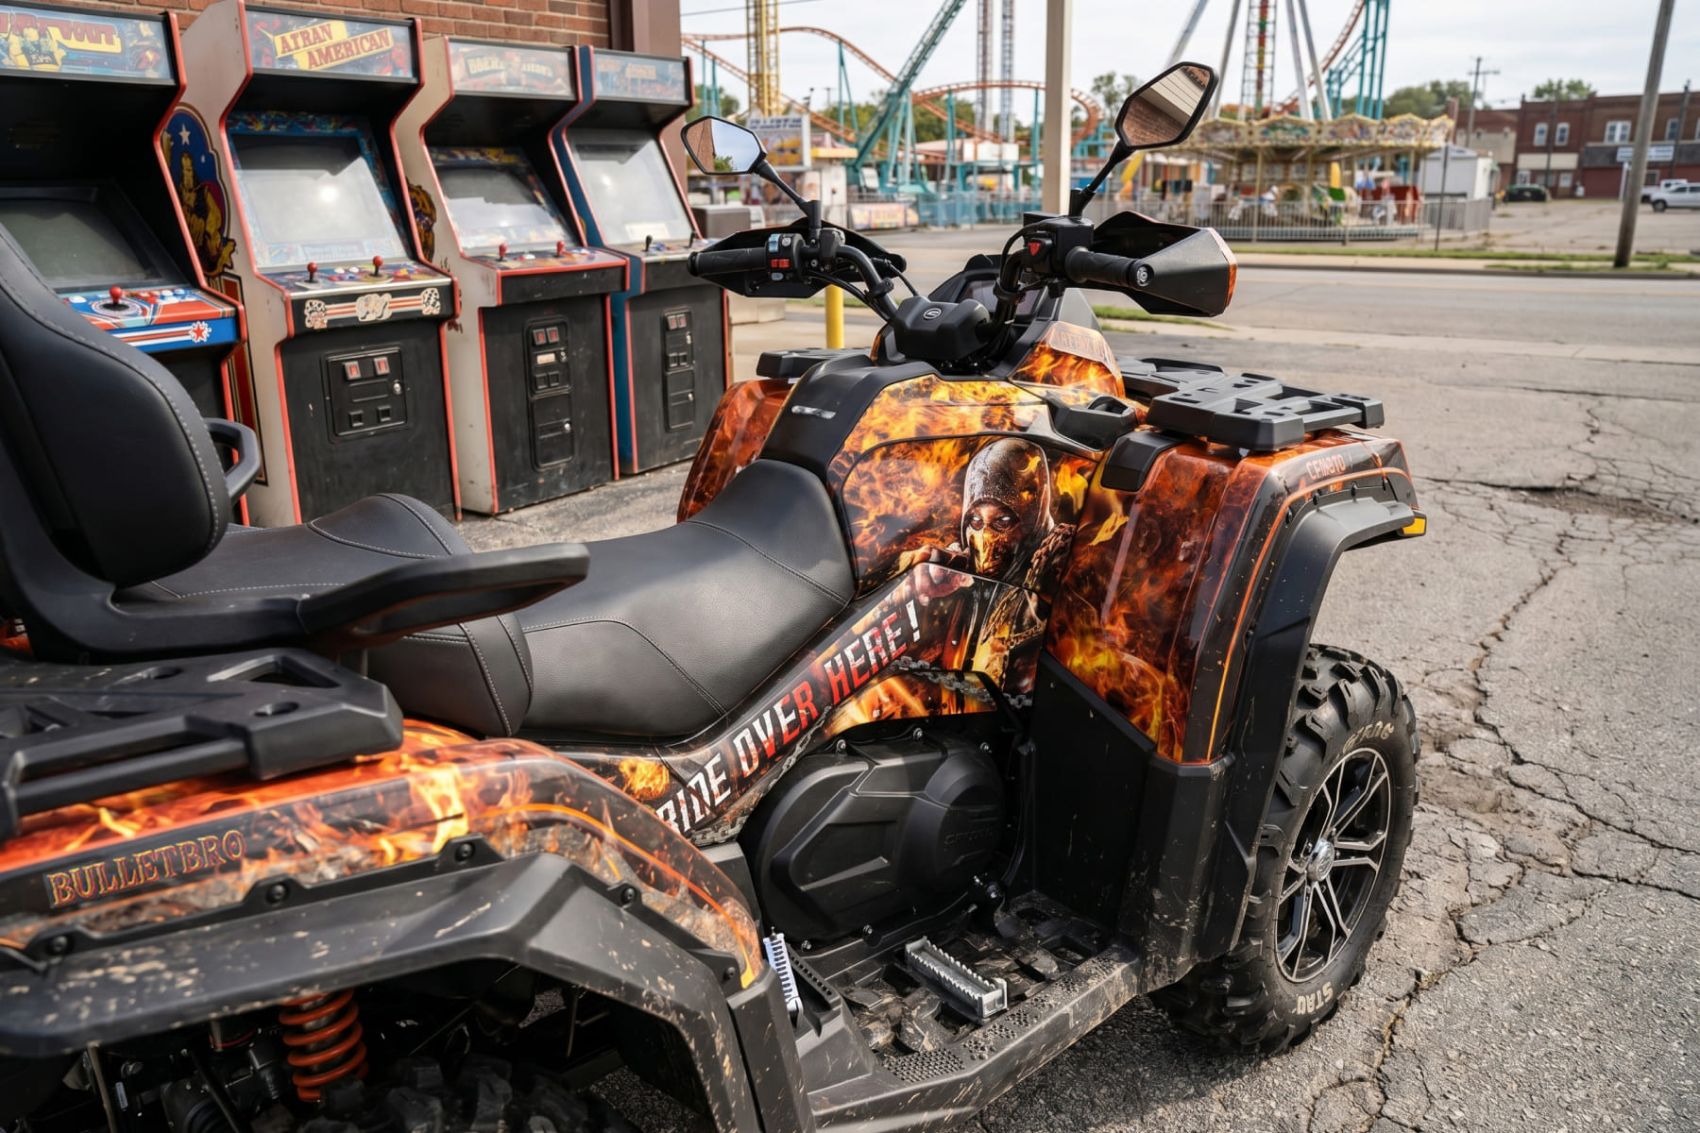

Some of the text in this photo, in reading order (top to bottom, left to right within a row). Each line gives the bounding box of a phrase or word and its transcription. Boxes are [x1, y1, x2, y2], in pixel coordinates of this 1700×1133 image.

[307, 29, 391, 70] AMERICAN
[733, 680, 819, 779] OVER
[823, 600, 921, 705] HERE!
[48, 829, 247, 905] BULLETBRO
